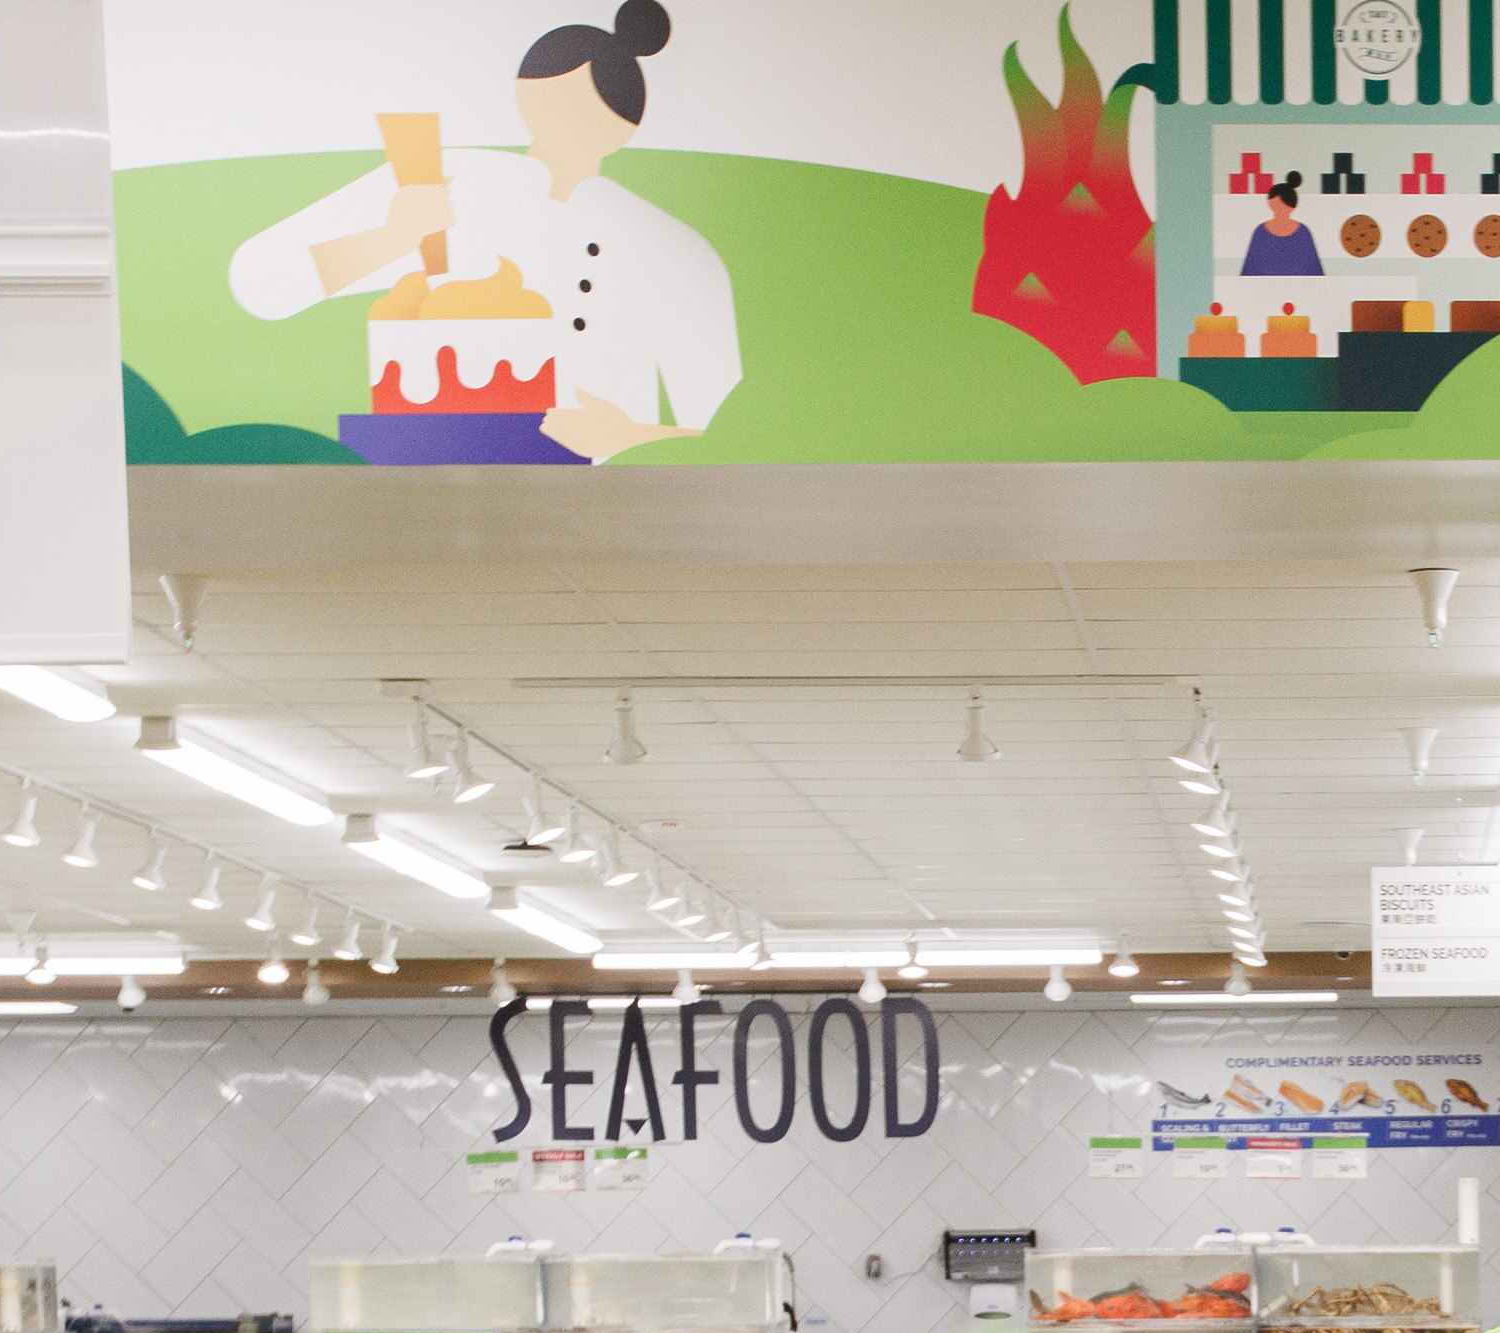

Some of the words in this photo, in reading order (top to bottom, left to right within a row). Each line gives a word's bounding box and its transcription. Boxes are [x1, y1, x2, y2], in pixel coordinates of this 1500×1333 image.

[1379, 884, 1451, 896] SOUTHEAST
[1455, 883, 1489, 895] ASIAN
[1380, 899, 1434, 911] BISCUITS
[1381, 947, 1429, 960] FROZEN
[1432, 947, 1488, 959] SEAFOOD
[1226, 1054, 1343, 1069] COMPLIMENTARY
[1347, 1053, 1412, 1068] SEAFOOD
[1416, 1053, 1482, 1067] SERVICES
[489, 997, 940, 1143] SEAFOOD
